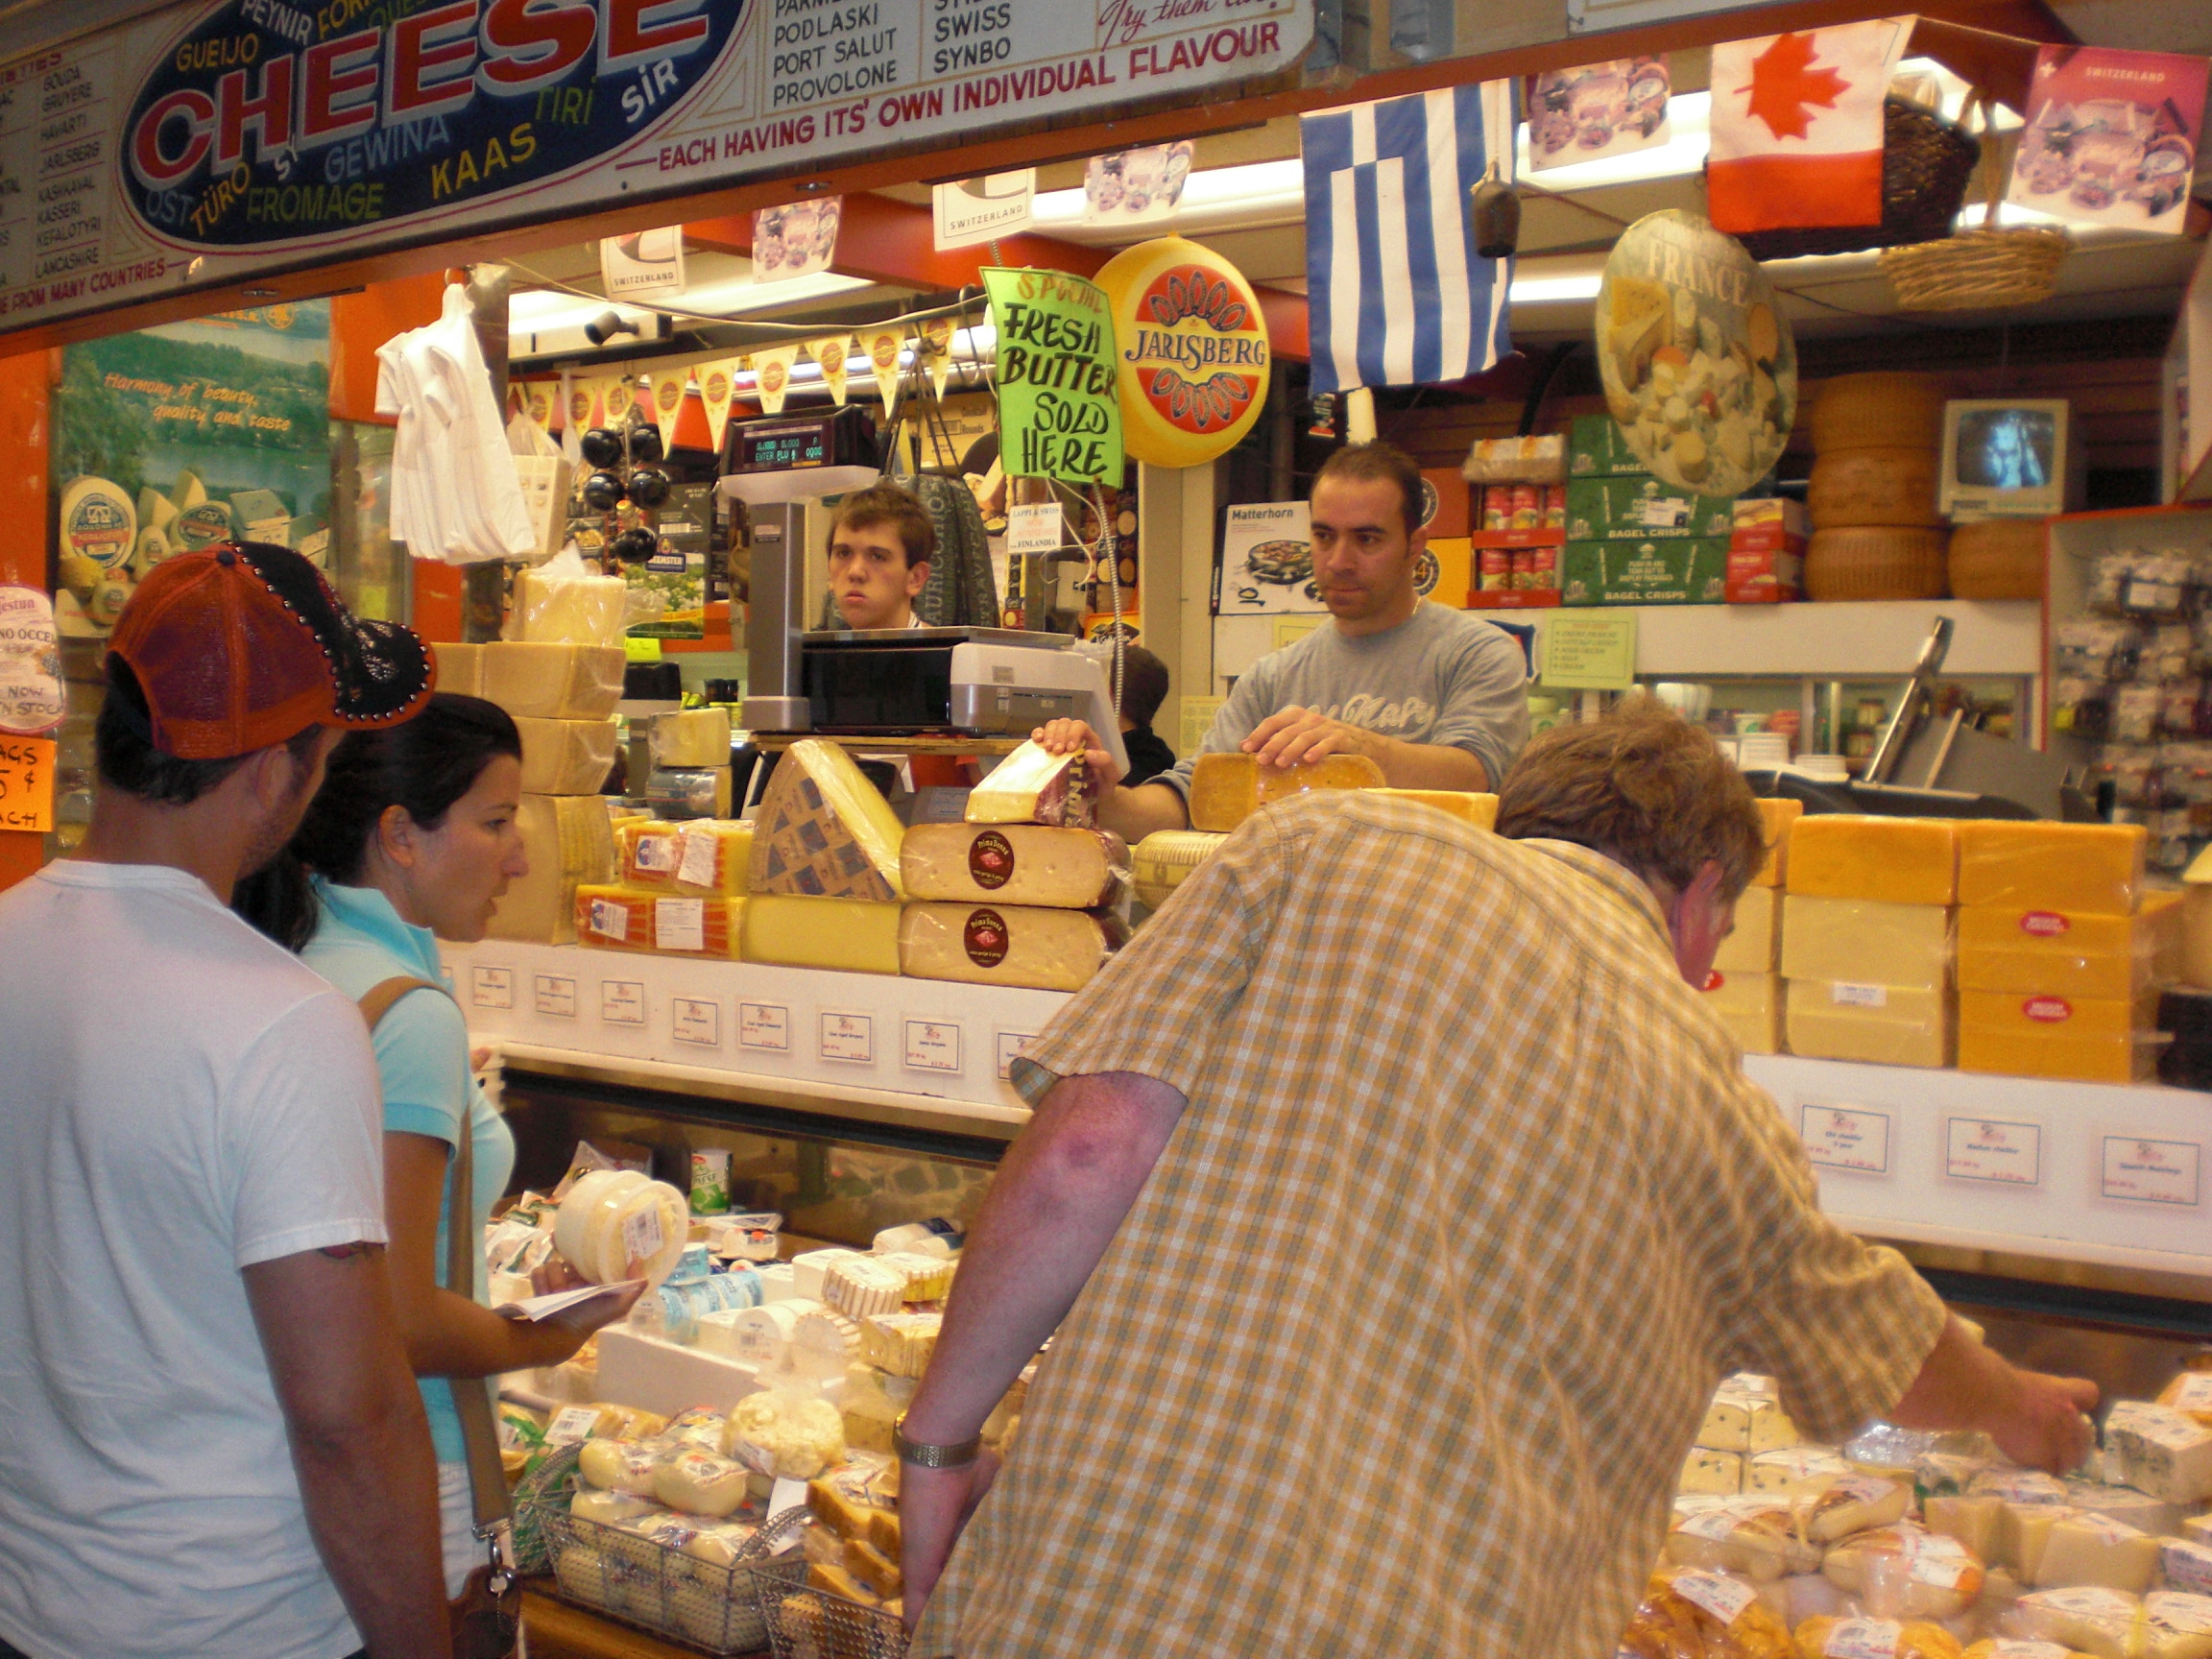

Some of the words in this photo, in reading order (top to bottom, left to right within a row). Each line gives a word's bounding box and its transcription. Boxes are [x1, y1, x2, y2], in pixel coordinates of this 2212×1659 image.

[774, 3, 878, 47] PODLASKI
[933, 3, 1011, 43] SWISS
[773, 45, 826, 78] PORT
[834, 27, 898, 63] SALUT
[932, 36, 1011, 73] SYNBO
[130, 0, 710, 191] CHEESE
[772, 59, 898, 108] PROVOLONE
[2085, 65, 2166, 84] SWITZERLAND
[659, 135, 715, 172] EACH
[725, 113, 815, 160] HAVING
[878, 87, 943, 128] OWN
[953, 55, 1117, 113] INDIVIDUAL
[1128, 20, 1282, 80] FLAVOUR
[431, 122, 538, 200] KAAS
[145, 189, 194, 227] OST
[246, 181, 384, 223] FROMAGE
[950, 204, 1024, 230] SWITZERLAND
[12, 287, 46, 312] FROM
[90, 257, 165, 293] COUNTRIES
[613, 271, 675, 288] SWITZERLAND
[1647, 236, 1749, 307] FRANCE
[1003, 301, 1101, 354] FRESH
[1123, 328, 1267, 373] JARLSBERG
[104, 371, 174, 402] Harmony
[178, 381, 200, 399] of
[998, 345, 1117, 404] BUTTER
[152, 403, 208, 429] quality
[212, 410, 243, 426] and
[248, 414, 292, 432] taste
[1033, 390, 1109, 436] SOLD
[1021, 426, 1109, 476] HERE
[1232, 508, 1294, 520] Matterhorn
[1608, 529, 1645, 539] BAGEL
[1648, 528, 1691, 538] CRISPS
[1018, 538, 1057, 549] FINLANDIA
[1604, 591, 1643, 601] BAGEL
[1646, 590, 1688, 600] CRISPS
[8, 685, 44, 699] NOW
